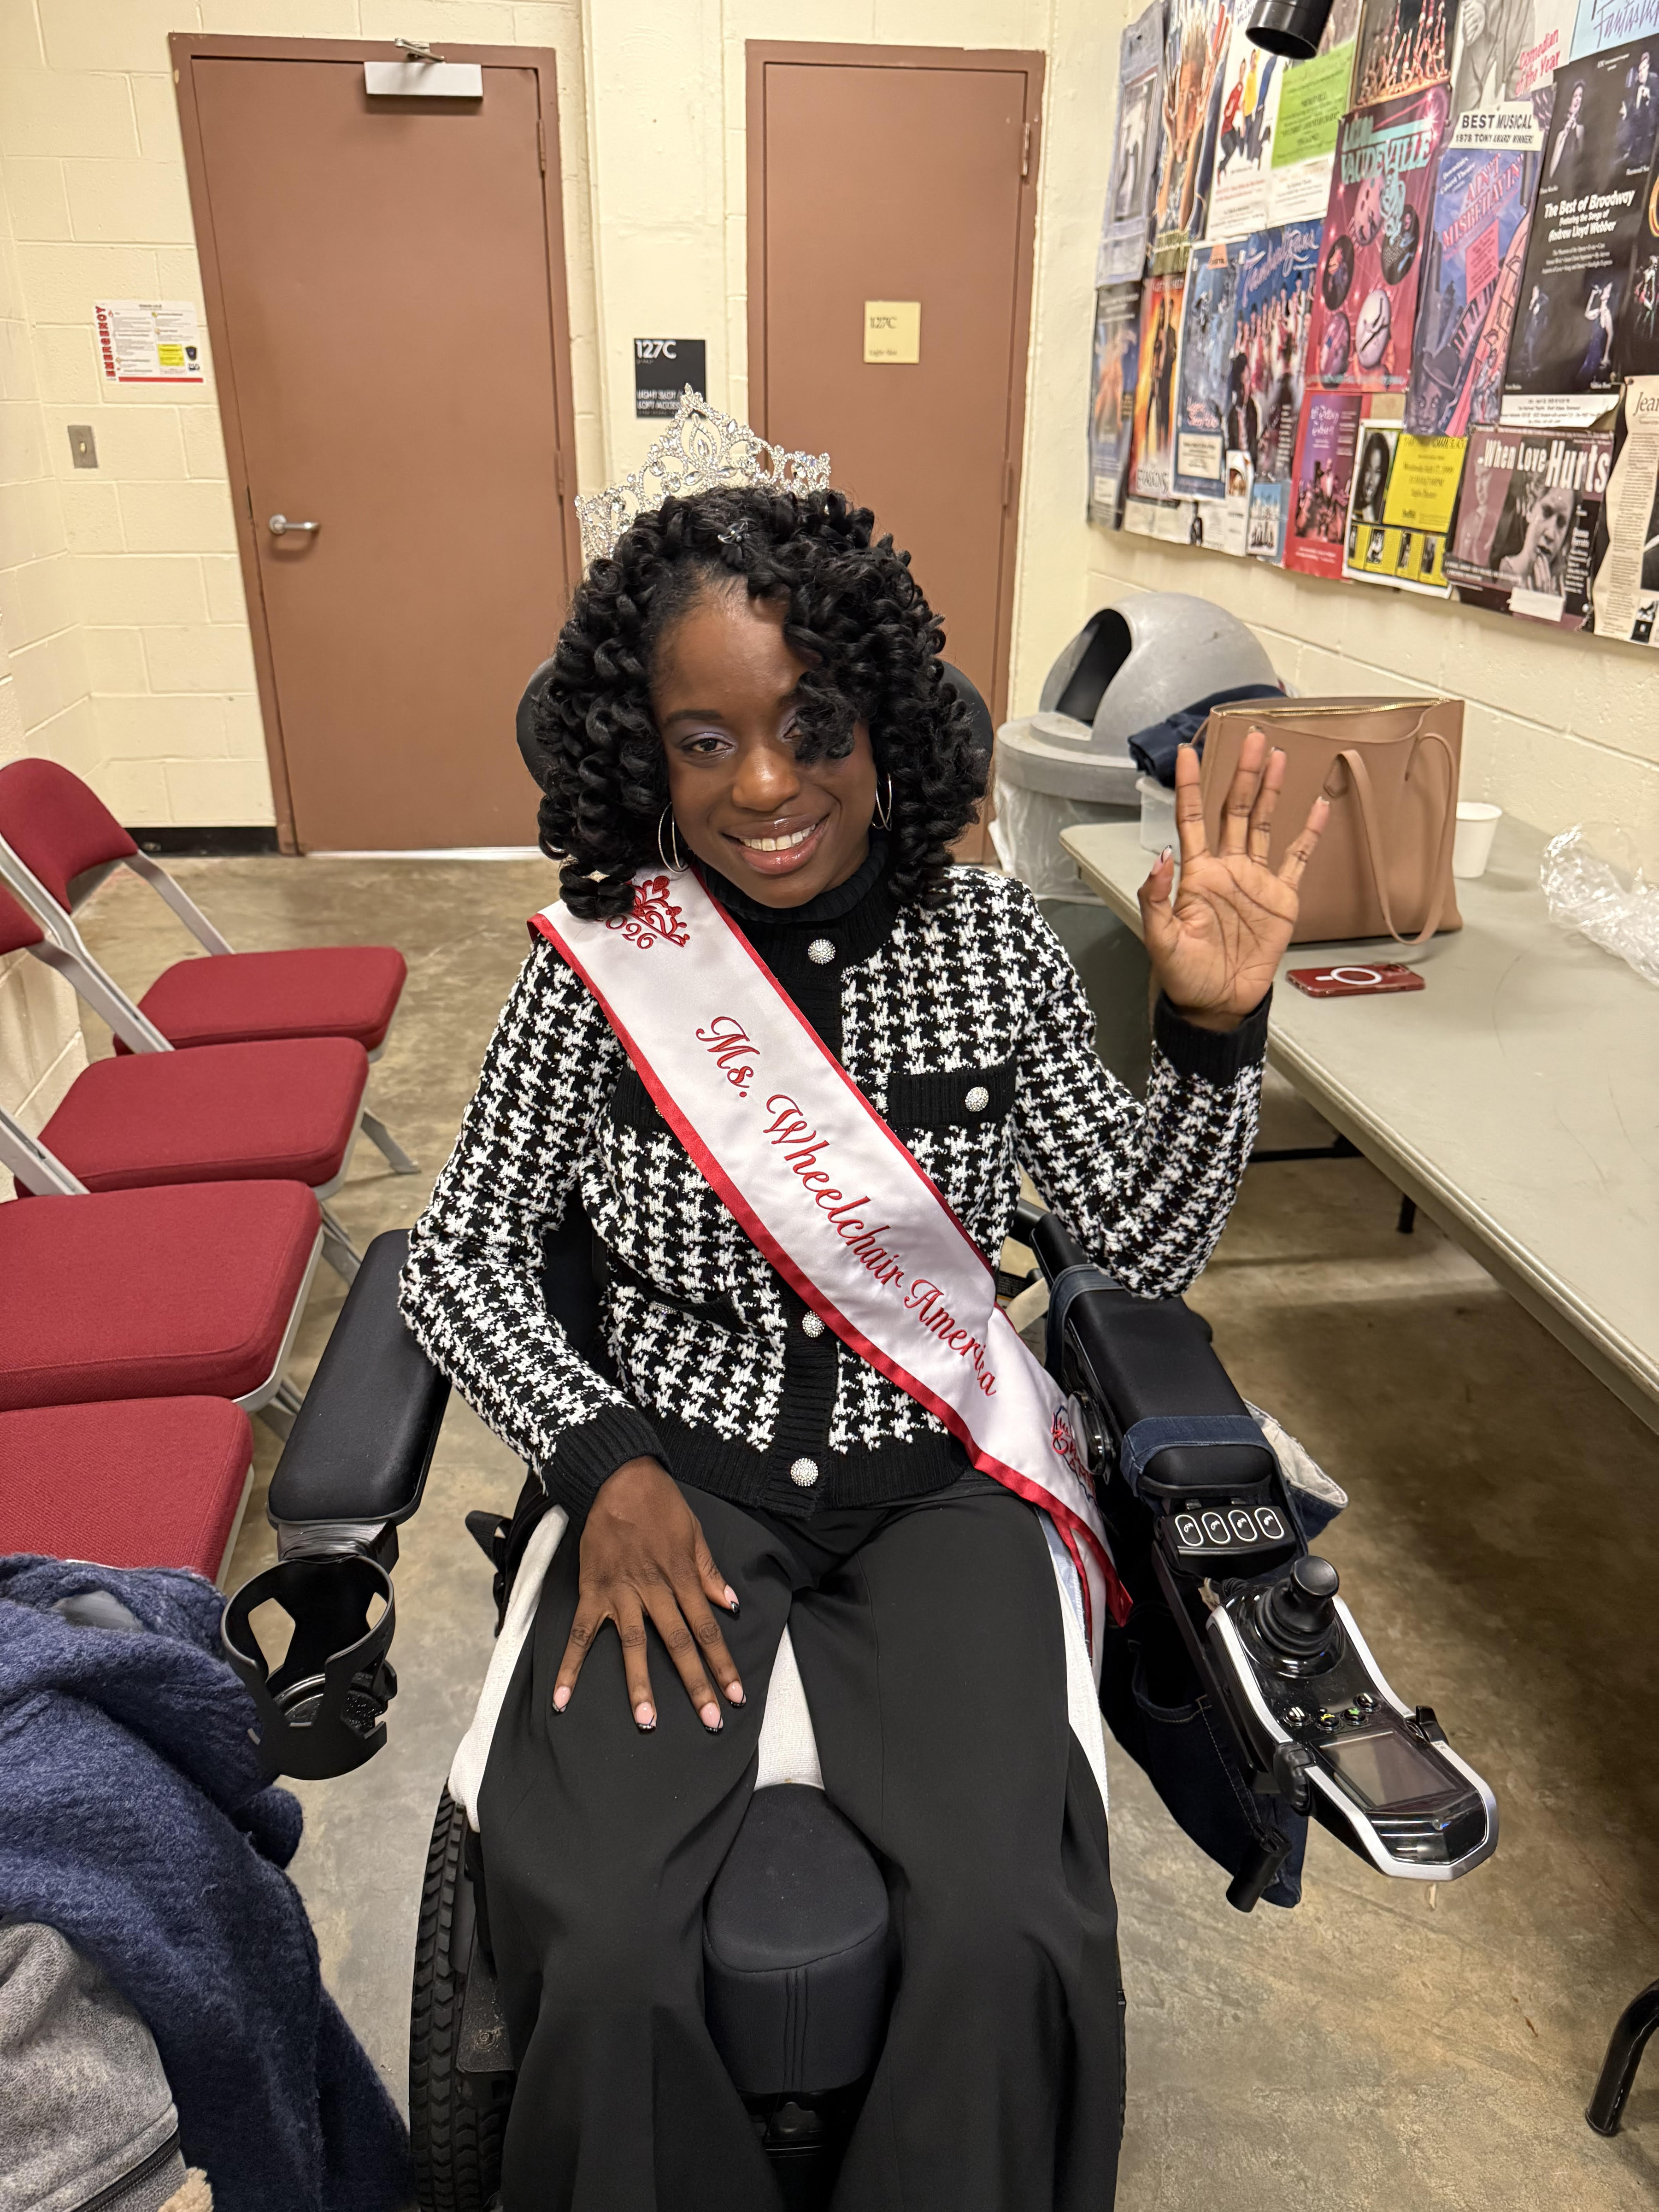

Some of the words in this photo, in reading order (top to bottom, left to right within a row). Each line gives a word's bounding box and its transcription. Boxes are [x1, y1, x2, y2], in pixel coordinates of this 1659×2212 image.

[1519, 29, 1559, 71] Comedian
[1540, 51, 1561, 76] Year
[1462, 114, 1495, 129] BEST
[1496, 114, 1532, 129] MUSICAL
[1474, 133, 1493, 143] TONY
[1341, 131, 1432, 185] VAUDEVILLE
[1544, 203, 1559, 219] The
[1559, 199, 1577, 216] Best
[1577, 195, 1589, 212] of
[1588, 190, 1636, 210] Broadway
[1580, 212, 1588, 222] the
[1588, 211, 1603, 222] Songs
[1602, 209, 1610, 219] of
[1548, 228, 1572, 243] Andrew
[1571, 224, 1589, 239] Lloyd
[1589, 220, 1617, 235] Webber
[870, 316, 898, 329] 127C
[95, 306, 116, 377] EMERGENCY
[635, 340, 677, 359] 127C
[1483, 439, 1517, 470] When
[1517, 441, 1547, 473] Love
[1544, 439, 1611, 494] Hurts
[595, 914, 658, 950] 026
[696, 1016, 760, 1098] Ms.
[763, 1094, 905, 1288] Wheelchair
